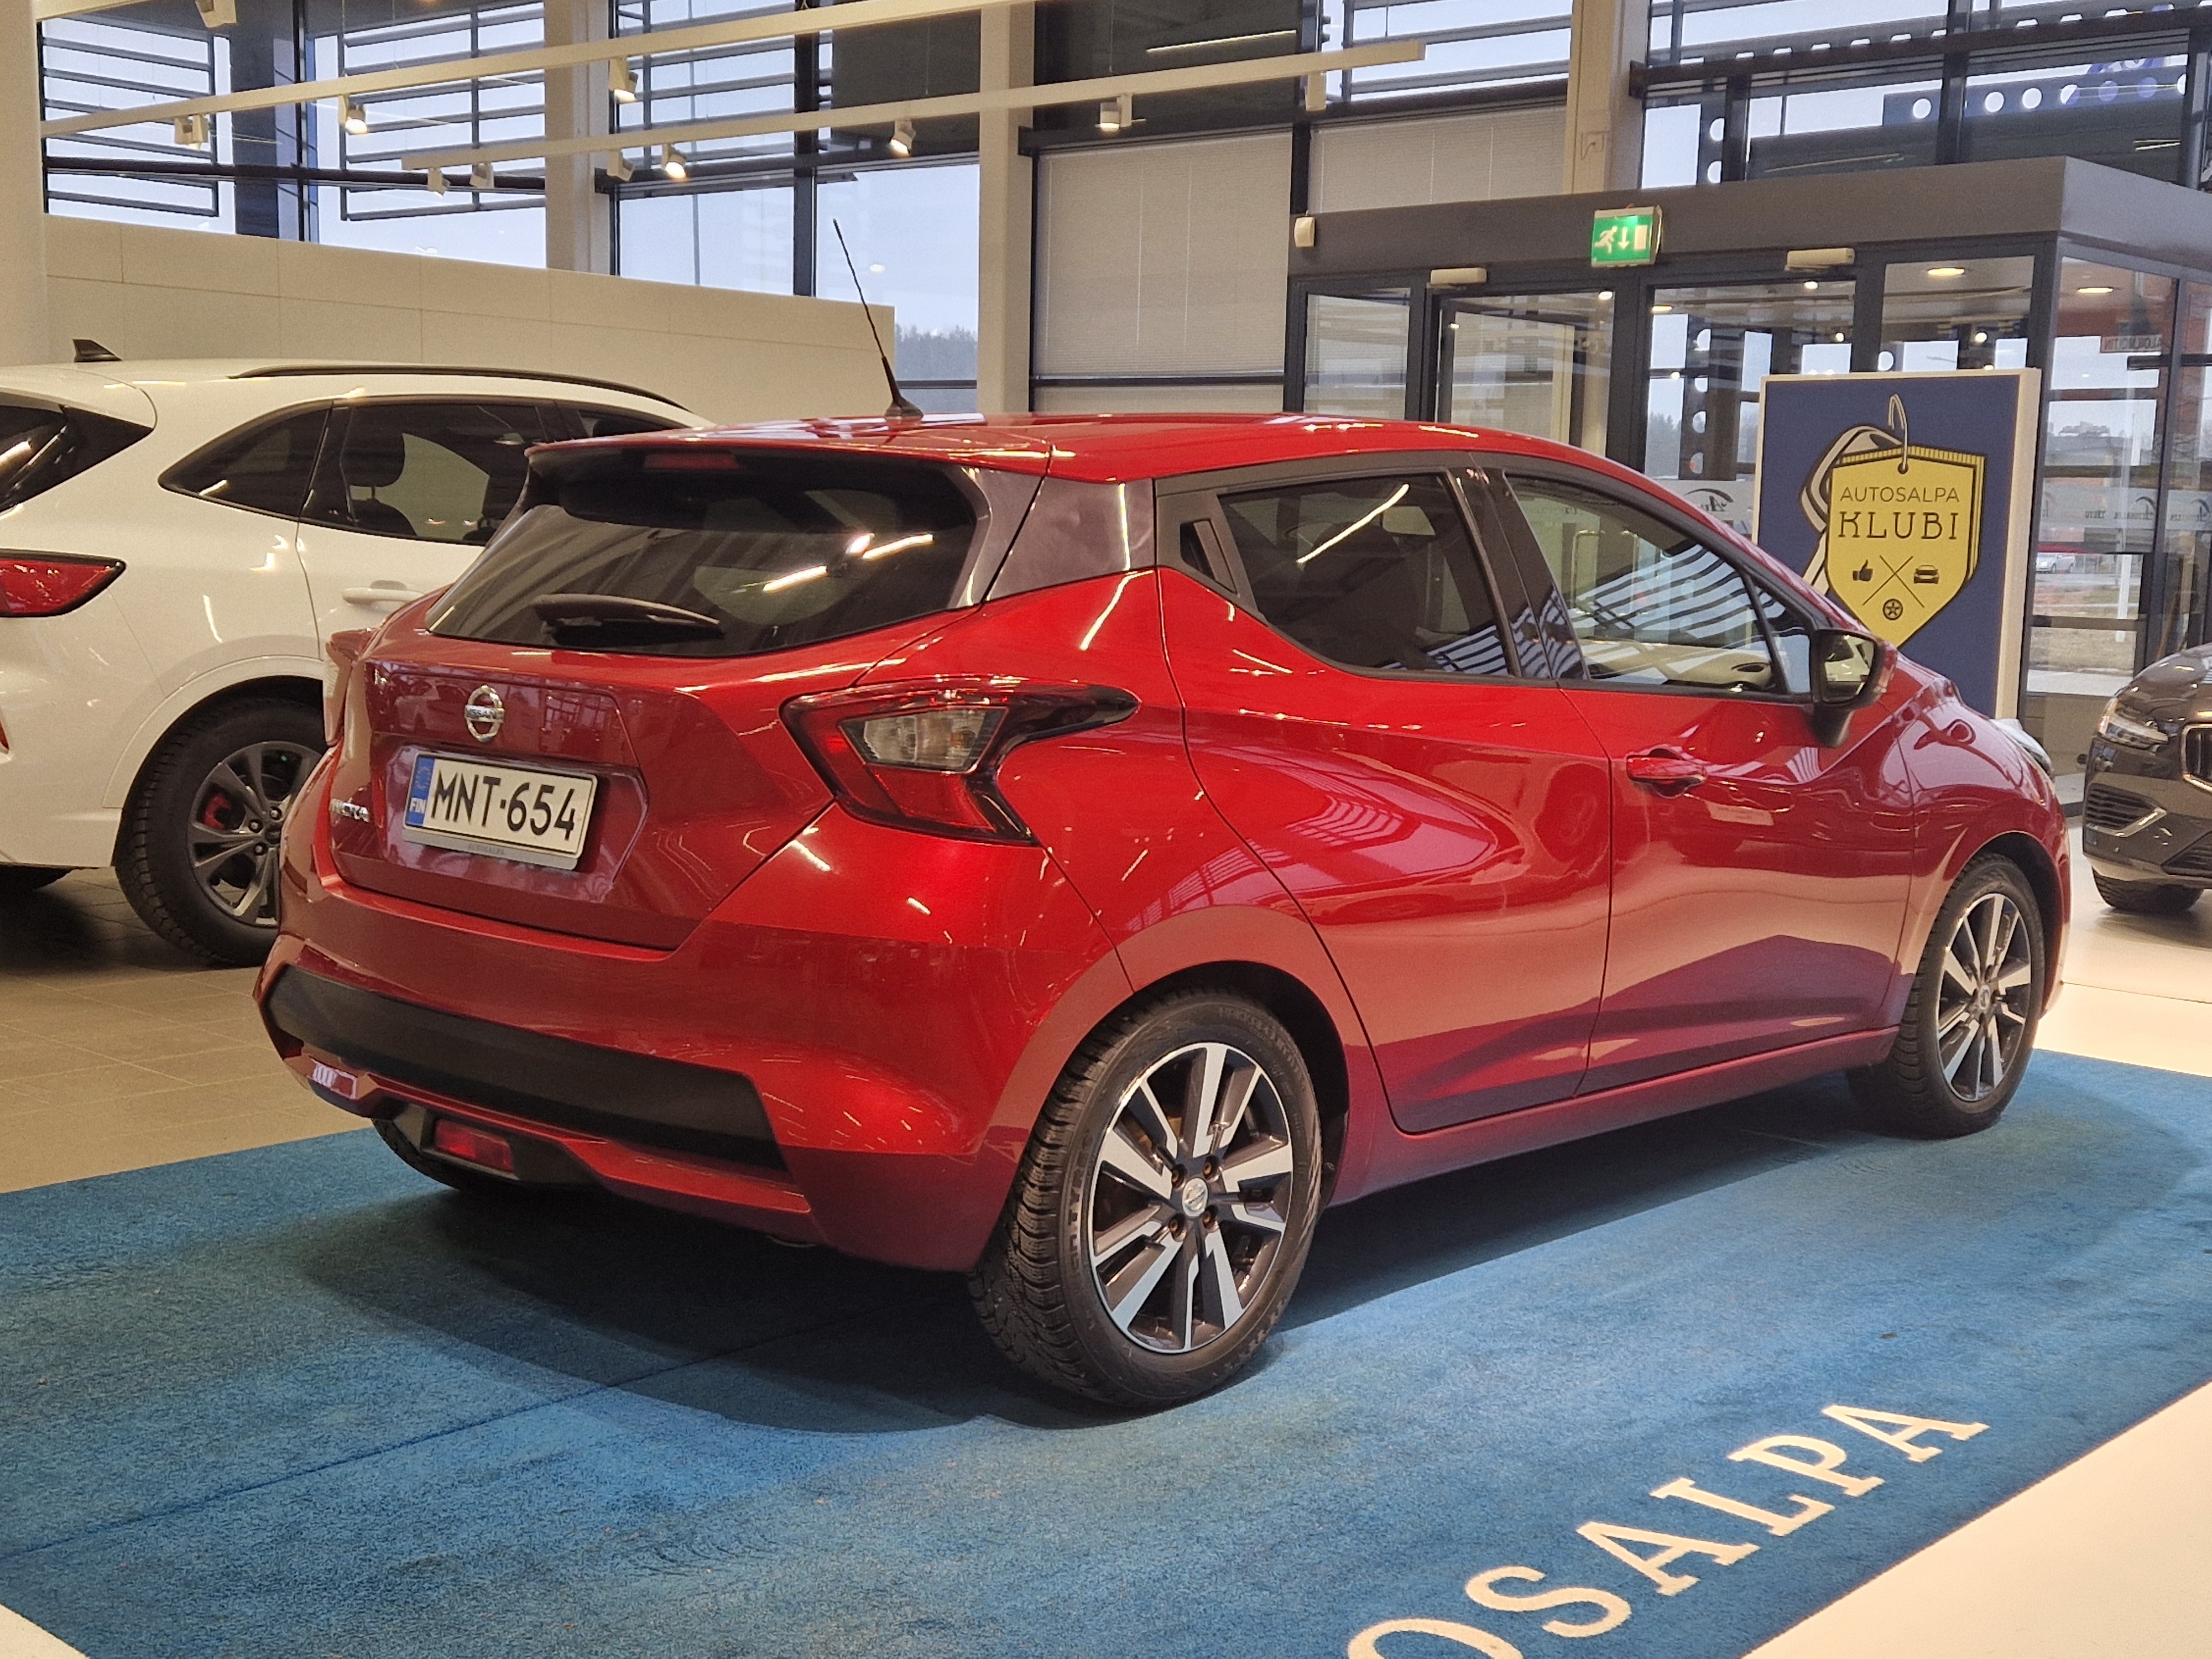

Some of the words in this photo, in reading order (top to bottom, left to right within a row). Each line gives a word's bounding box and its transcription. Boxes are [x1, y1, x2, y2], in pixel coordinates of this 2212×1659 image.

[1840, 486, 1960, 503] AUTOSALPA
[1838, 512, 1959, 540] KLUBI
[409, 797, 426, 813] FIN
[430, 770, 576, 841] MNT-654
